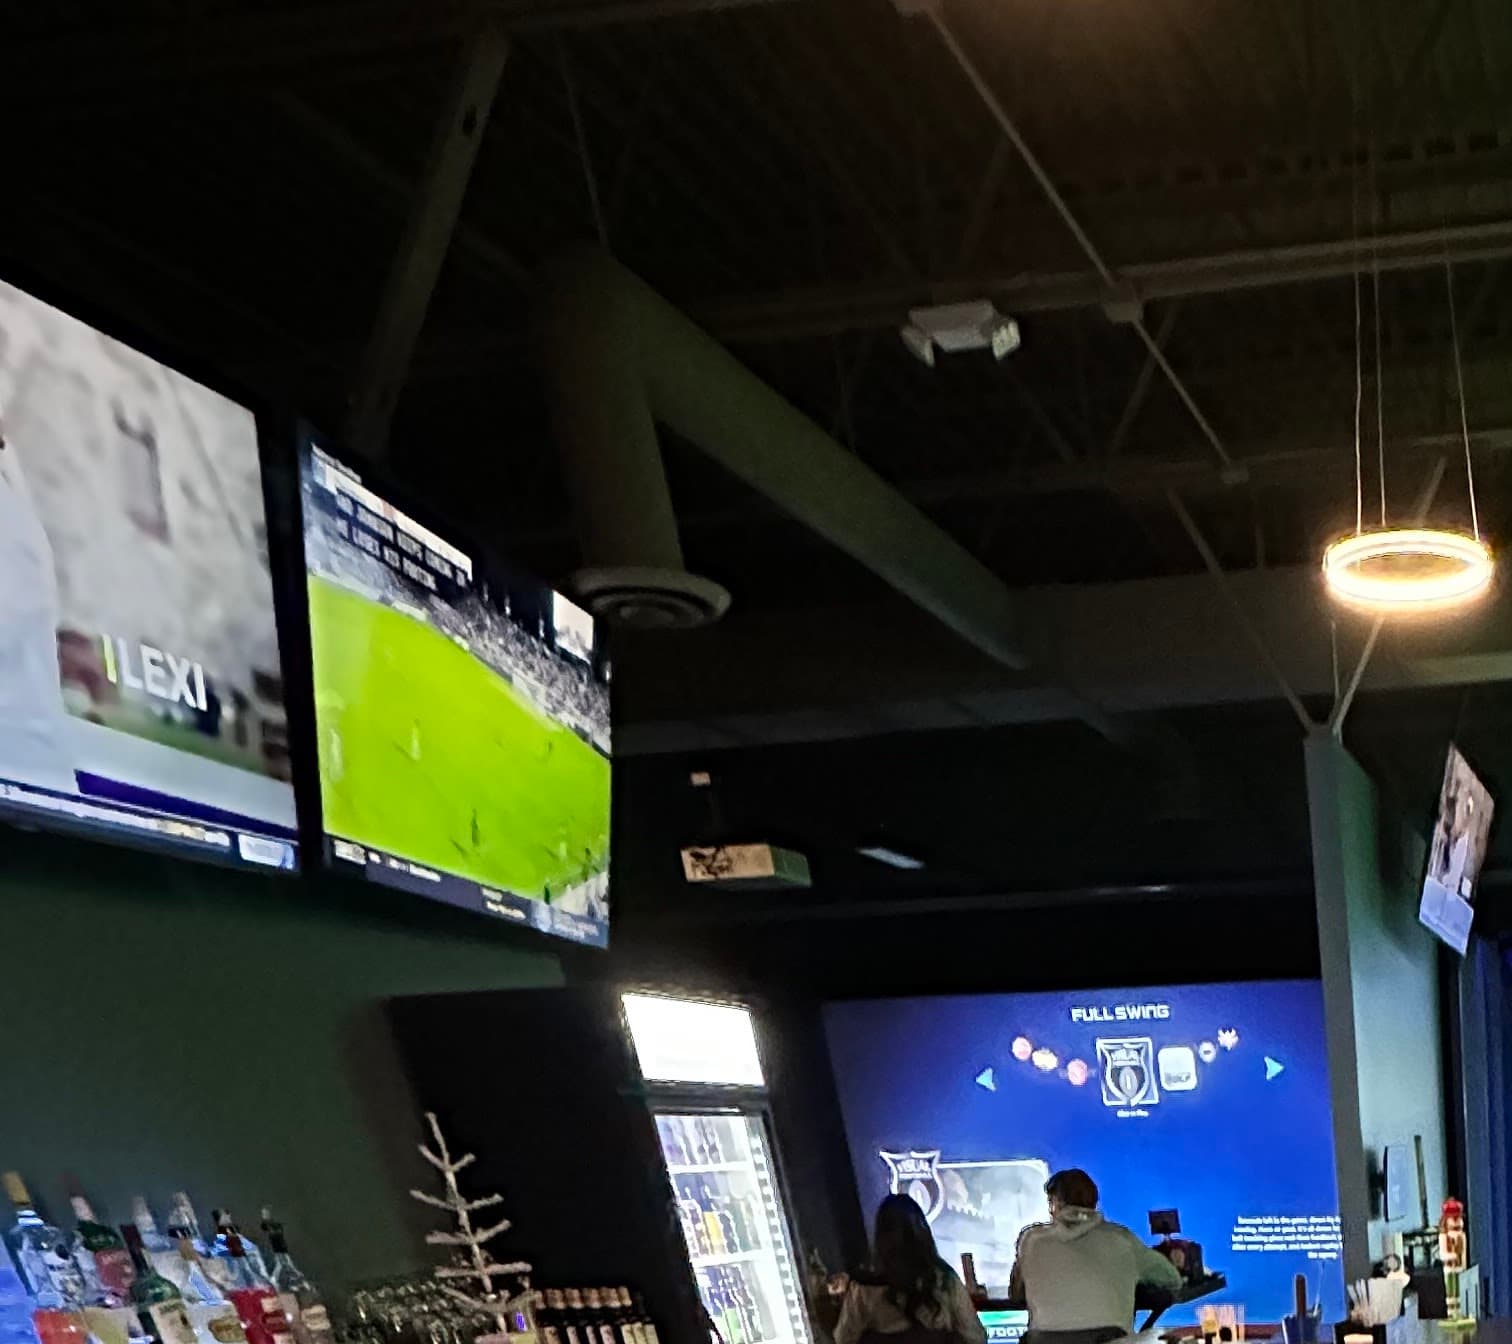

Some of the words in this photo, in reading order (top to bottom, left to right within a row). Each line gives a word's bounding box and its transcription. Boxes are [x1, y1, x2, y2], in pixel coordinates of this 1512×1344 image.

[116, 636, 208, 712] LEXI
[1071, 1006, 1114, 1022] FULL
[1114, 1003, 1170, 1020] SWING
[988, 1325, 1028, 1338] FOOT
